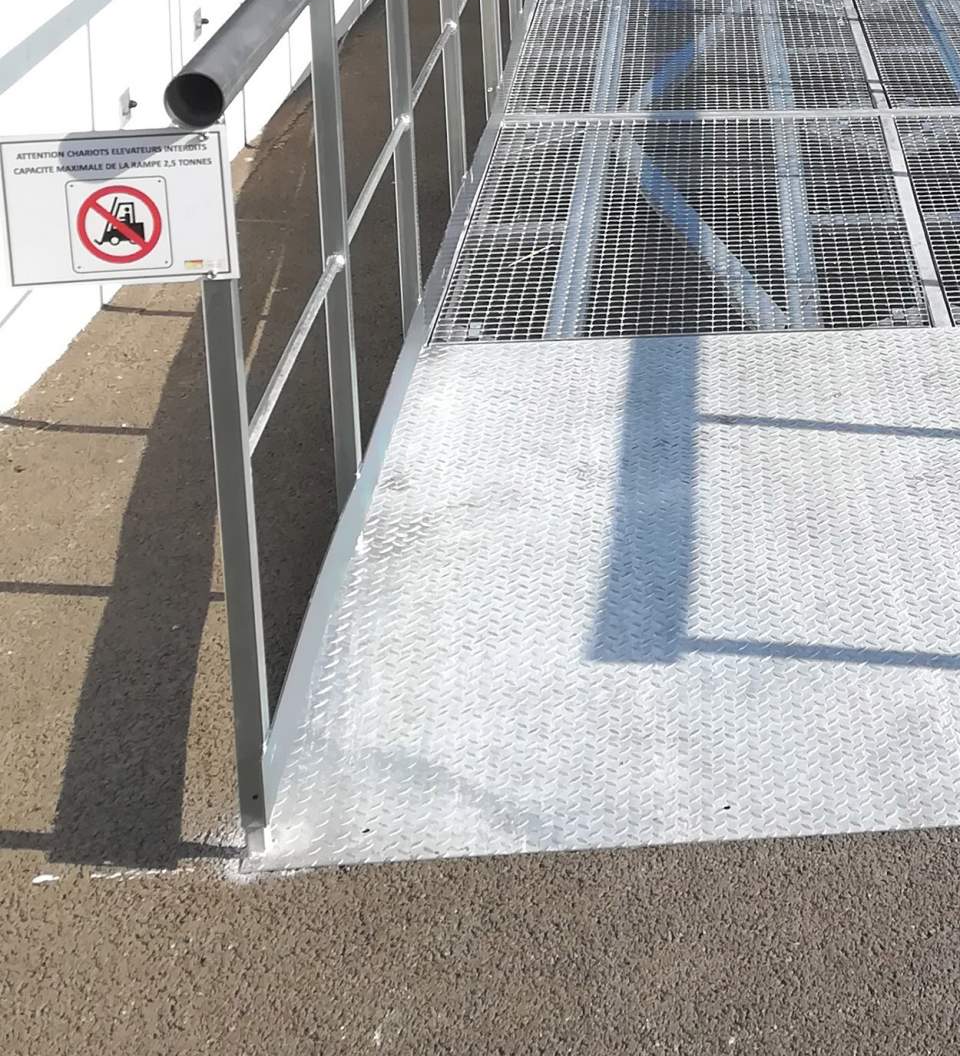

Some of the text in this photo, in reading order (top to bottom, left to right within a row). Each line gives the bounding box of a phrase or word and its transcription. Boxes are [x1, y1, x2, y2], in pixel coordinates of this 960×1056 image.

[16, 144, 207, 160] ATTENTION CHARIOTS ELEVATEURS INTERDITS
[13, 166, 54, 175] CAPACITE
[56, 163, 104, 172] MAXIMALE
[130, 160, 162, 168] RAMPE
[163, 160, 176, 168] 2,5
[178, 158, 212, 166] TONNES
